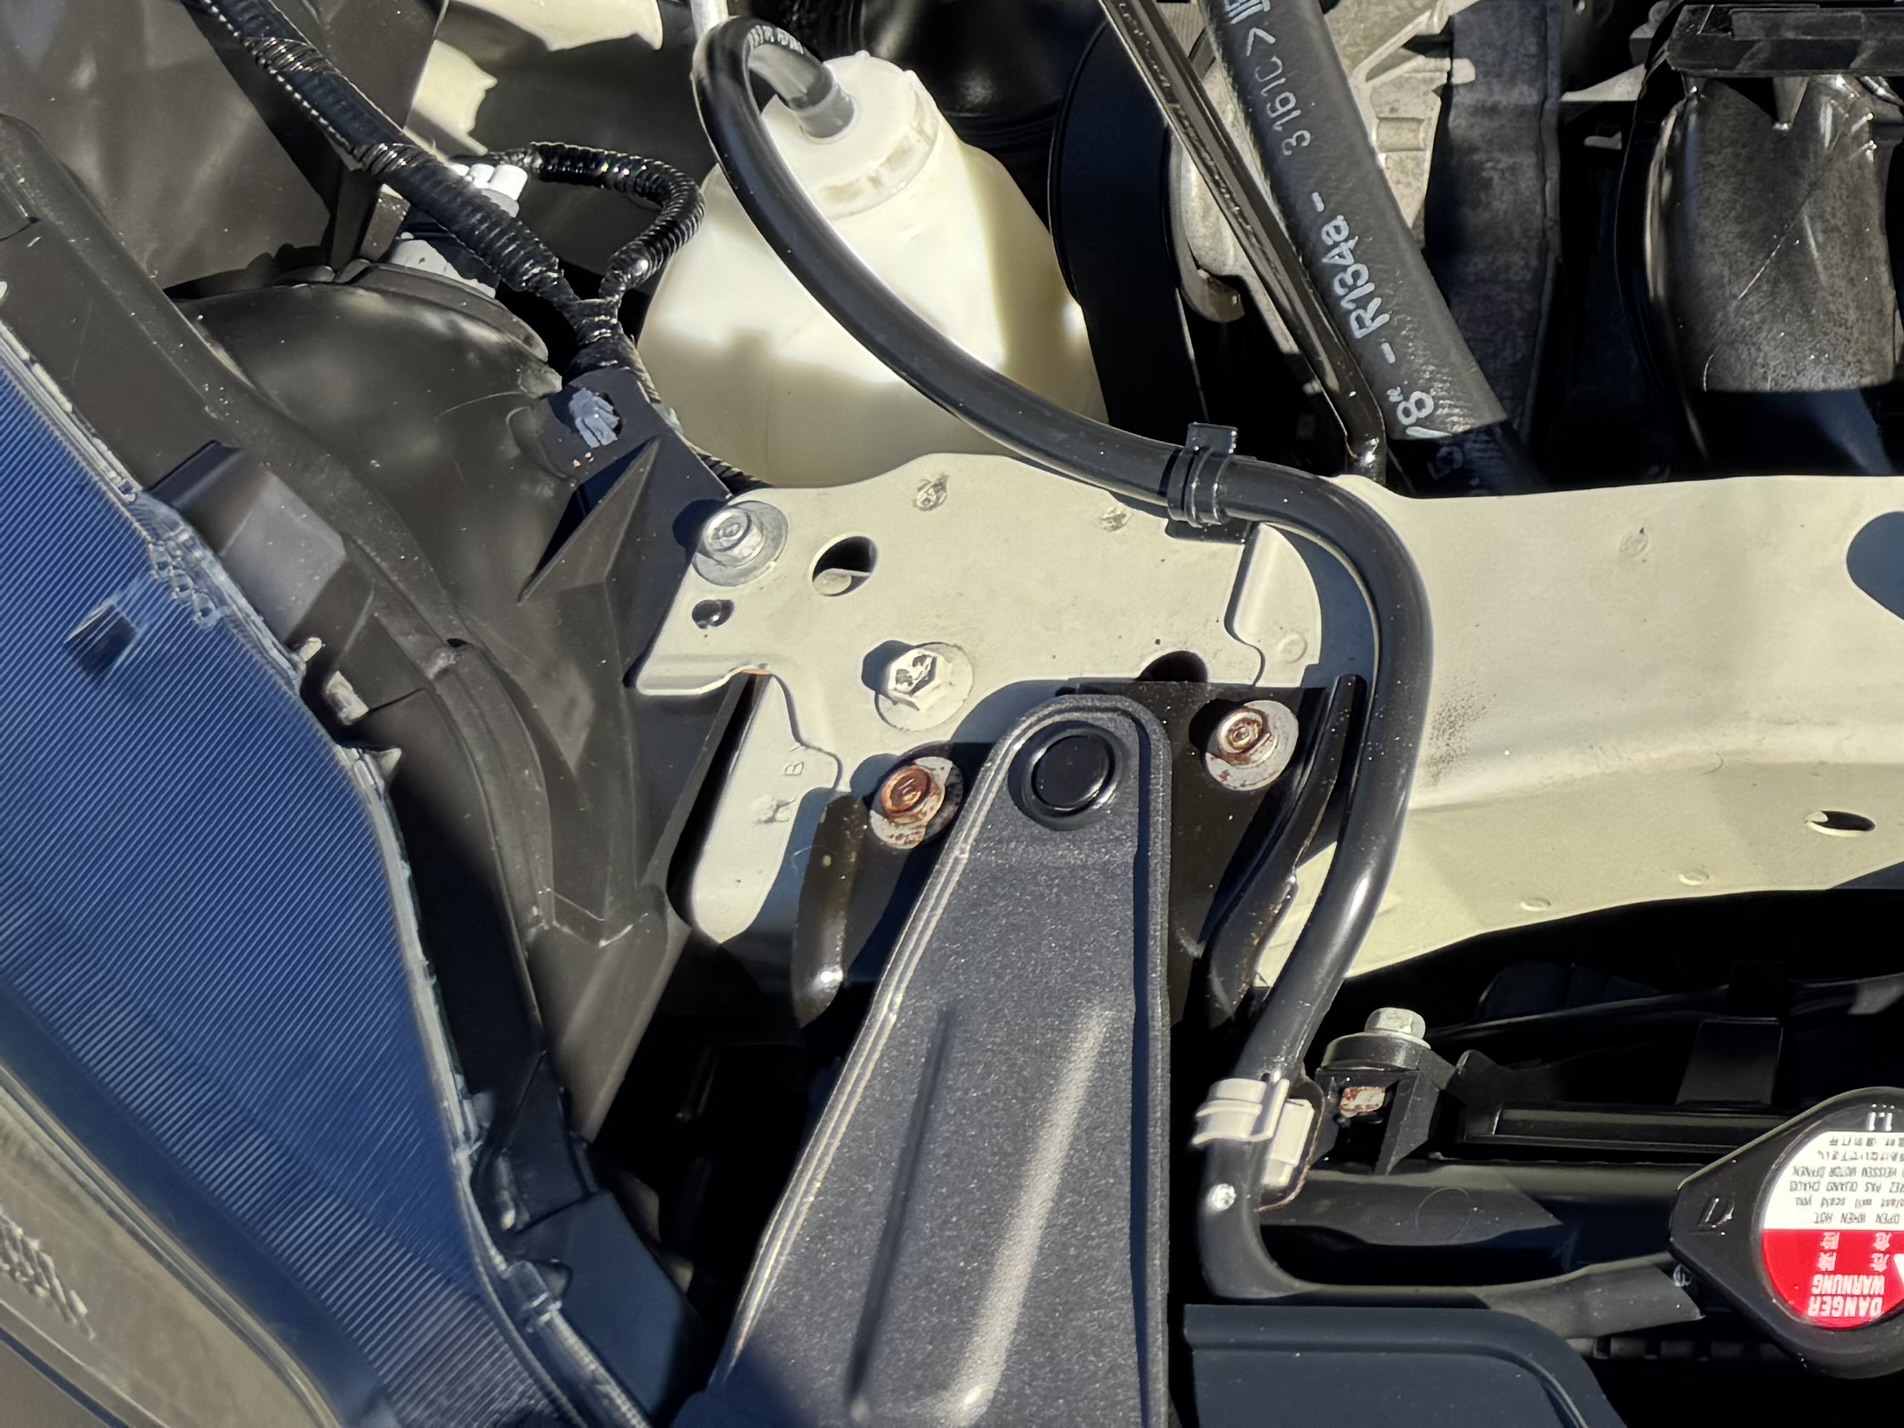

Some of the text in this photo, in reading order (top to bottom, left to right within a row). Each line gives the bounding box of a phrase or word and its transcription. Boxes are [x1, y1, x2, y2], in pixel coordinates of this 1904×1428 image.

[1319, 212, 1394, 341] R134a
[1821, 1197, 1845, 1207] scald
[1855, 1198, 1872, 1208] will
[1840, 1212, 1866, 1224] WHEN
[1875, 1213, 1900, 1225] OPEN
[1811, 1274, 1885, 1295] WARNUNG
[1807, 1295, 1883, 1318] DANGER
